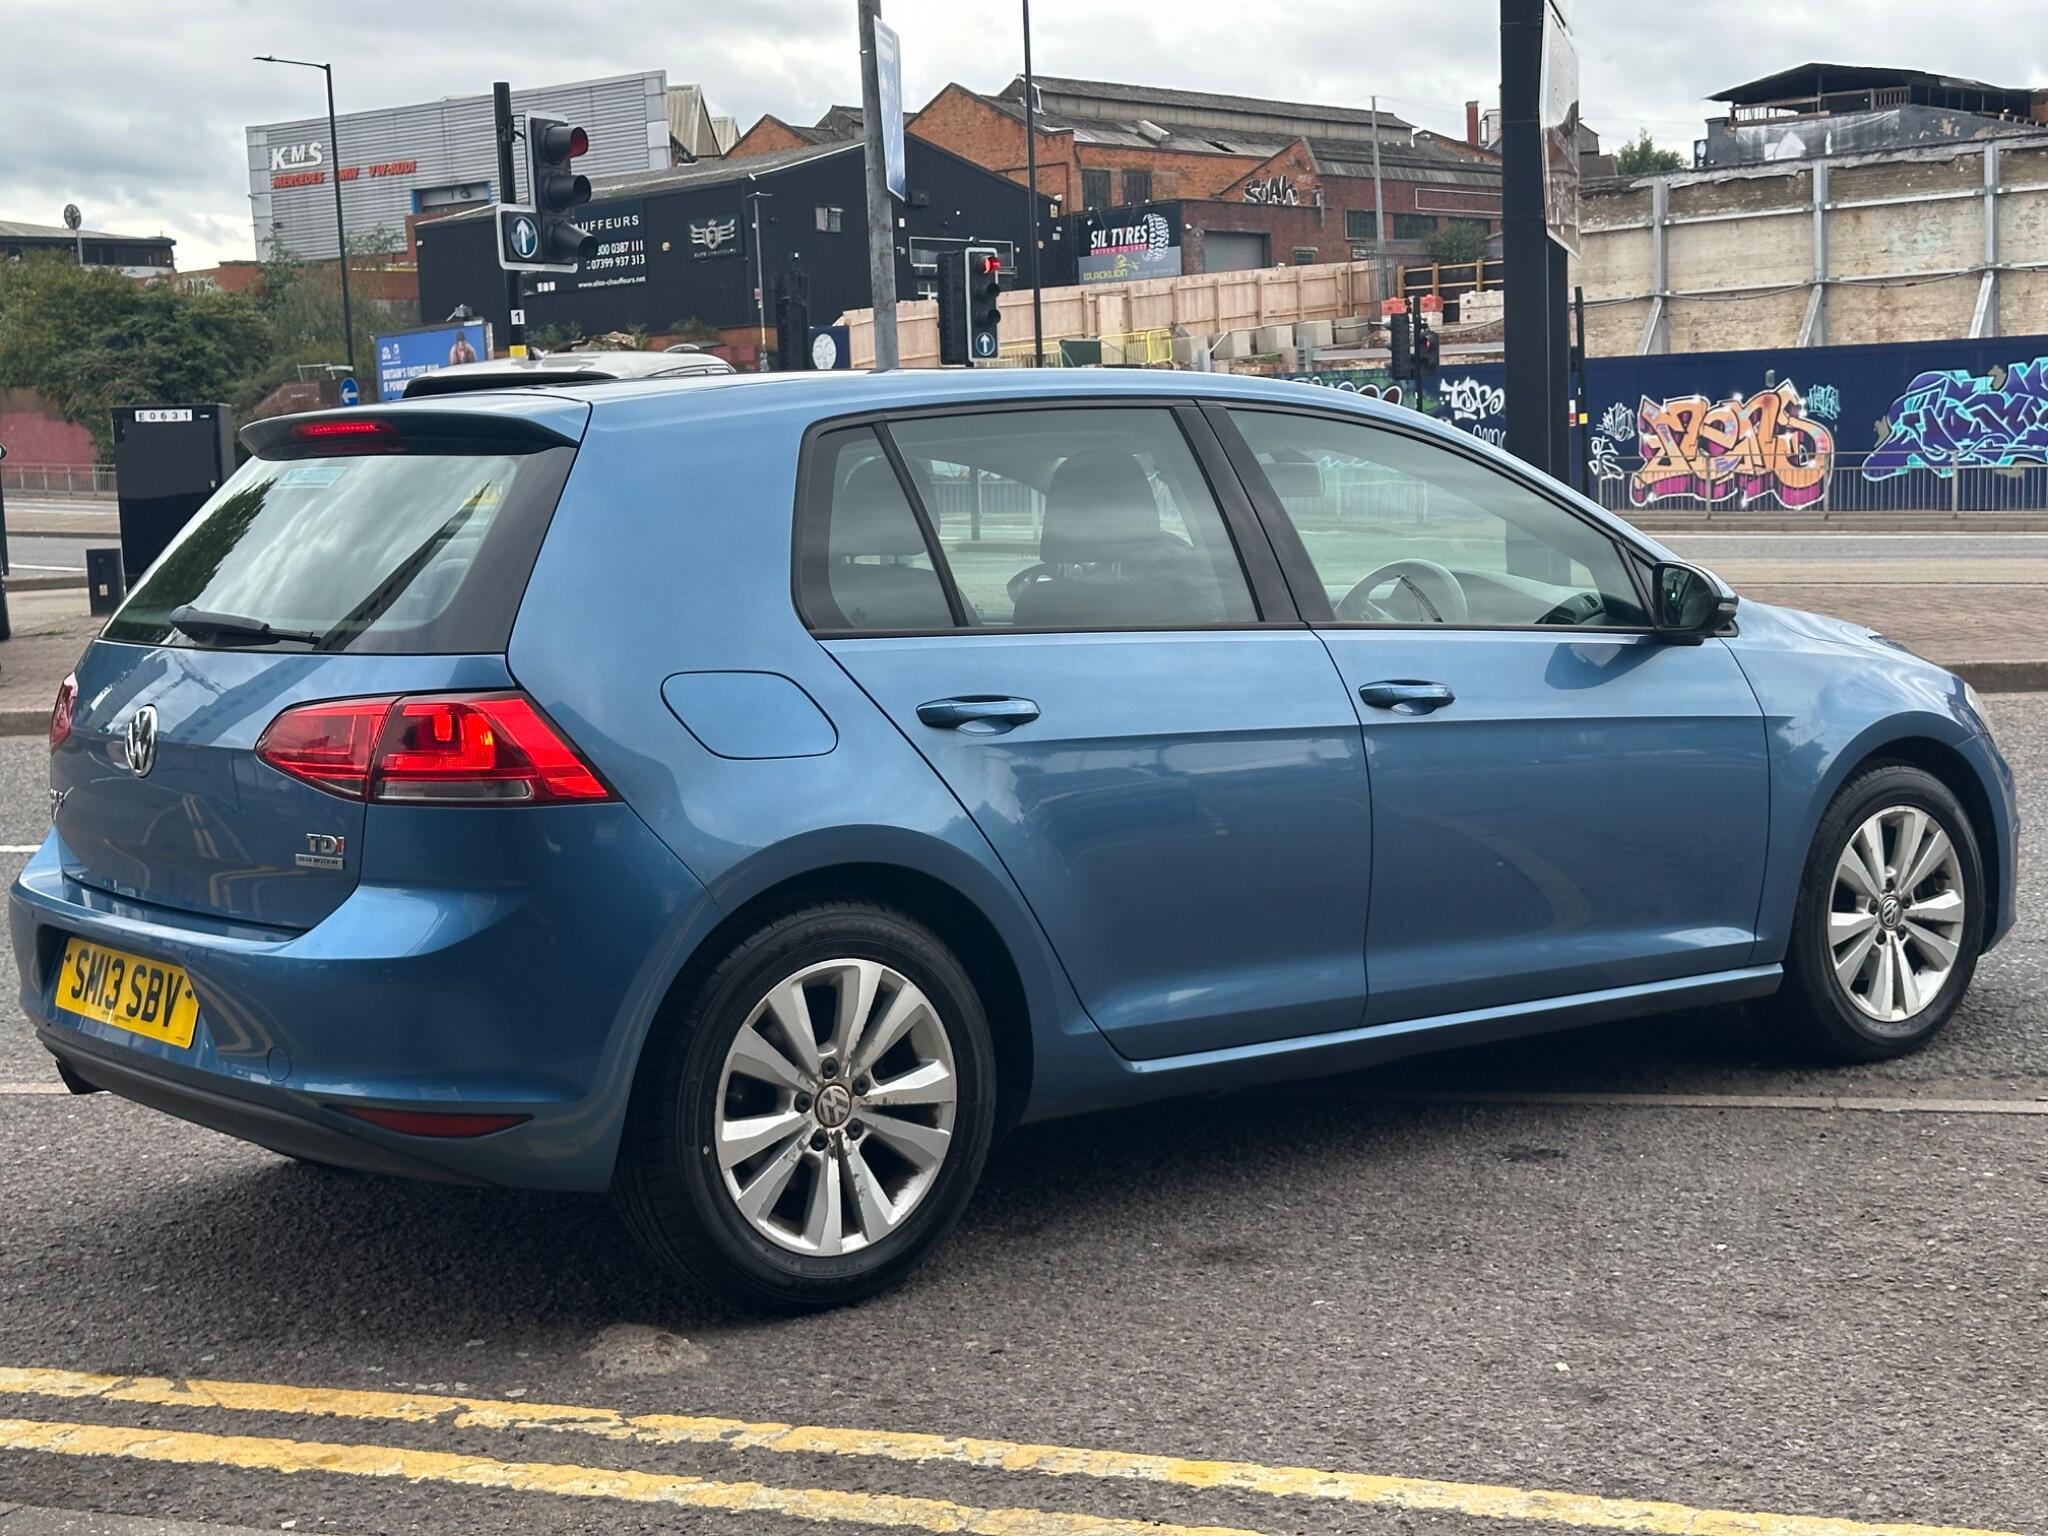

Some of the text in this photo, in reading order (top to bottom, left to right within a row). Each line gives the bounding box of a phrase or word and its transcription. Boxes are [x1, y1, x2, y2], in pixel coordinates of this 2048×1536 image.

[271, 141, 323, 171] KMS
[272, 171, 325, 188] MERCEDES
[334, 166, 360, 181] MW
[1090, 225, 1148, 249] SIL TYRES
[615, 256, 629, 267] 937
[631, 254, 645, 265] 313
[1090, 247, 1116, 256] DRIVEN
[1131, 243, 1148, 252] LAST
[514, 311, 522, 323] 1
[138, 411, 189, 421] E0631
[306, 833, 345, 855] TDI
[70, 948, 184, 1028] SM13 SBV
